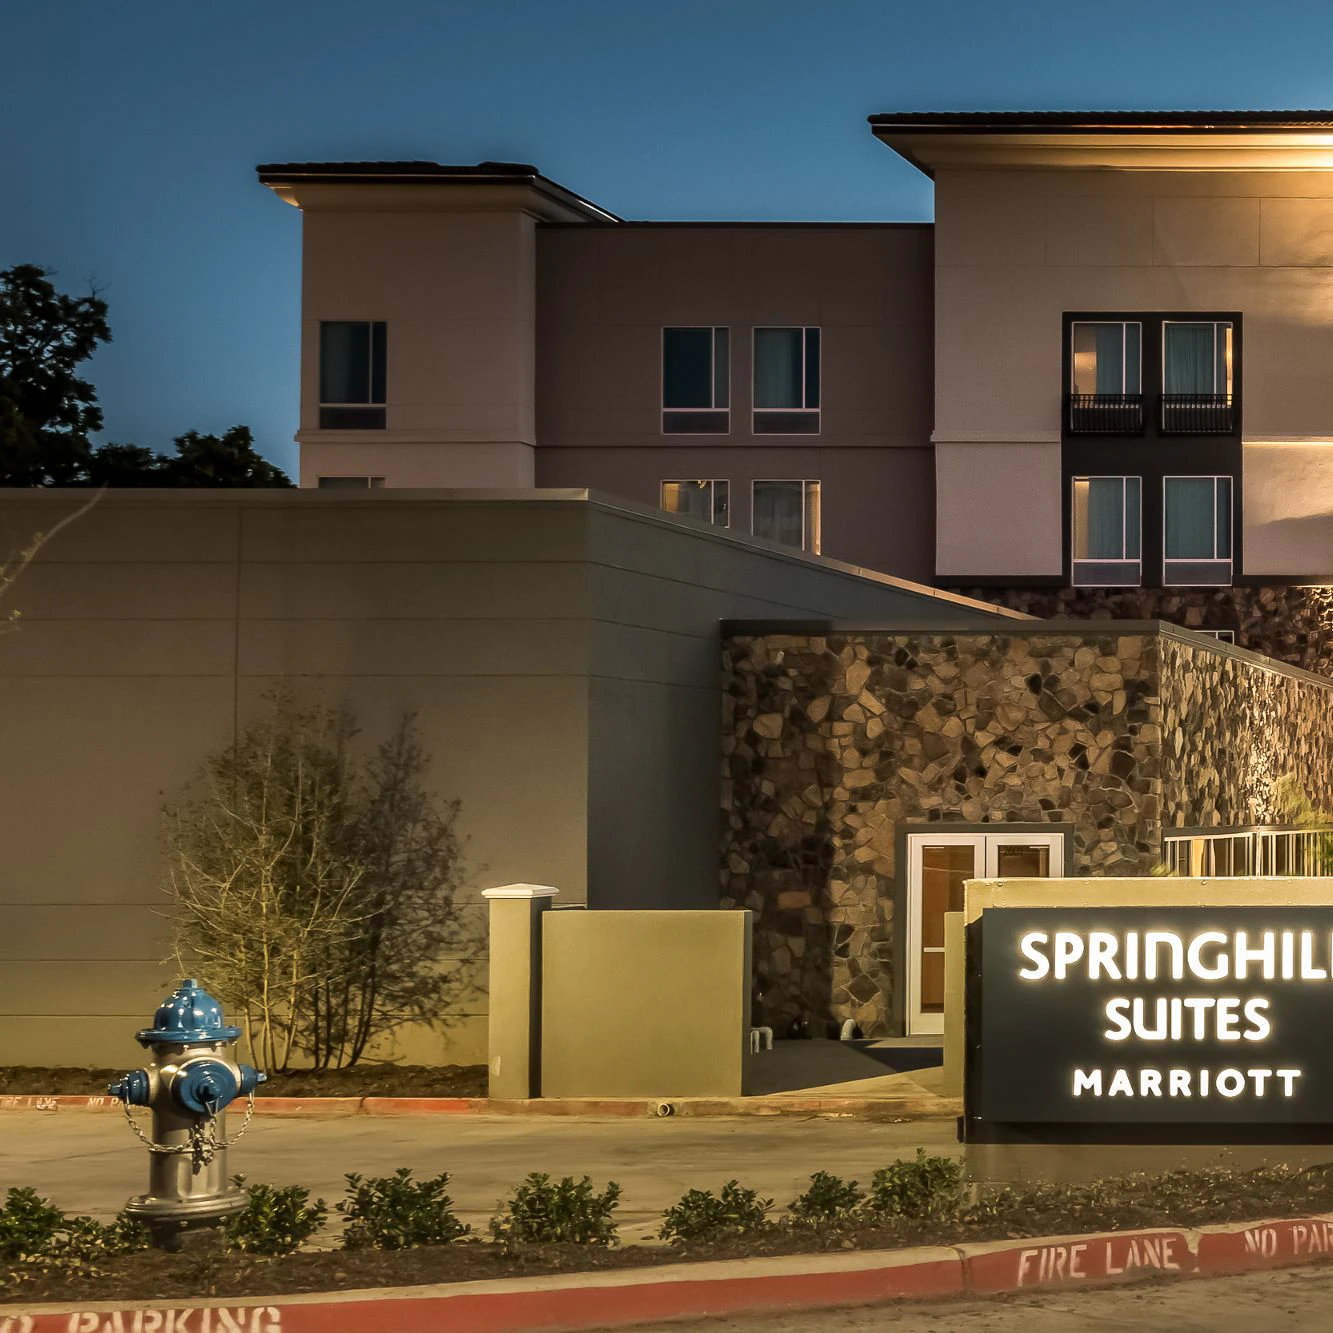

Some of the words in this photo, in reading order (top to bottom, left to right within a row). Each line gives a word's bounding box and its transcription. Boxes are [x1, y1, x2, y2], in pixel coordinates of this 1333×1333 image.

[1105, 998, 1271, 1041] SUITES
[1073, 1069, 1301, 1097] MARRIOTT
[1016, 1243, 1089, 1287] FIRE
[1106, 1238, 1180, 1274] LANE
[1245, 1228, 1277, 1258] NO
